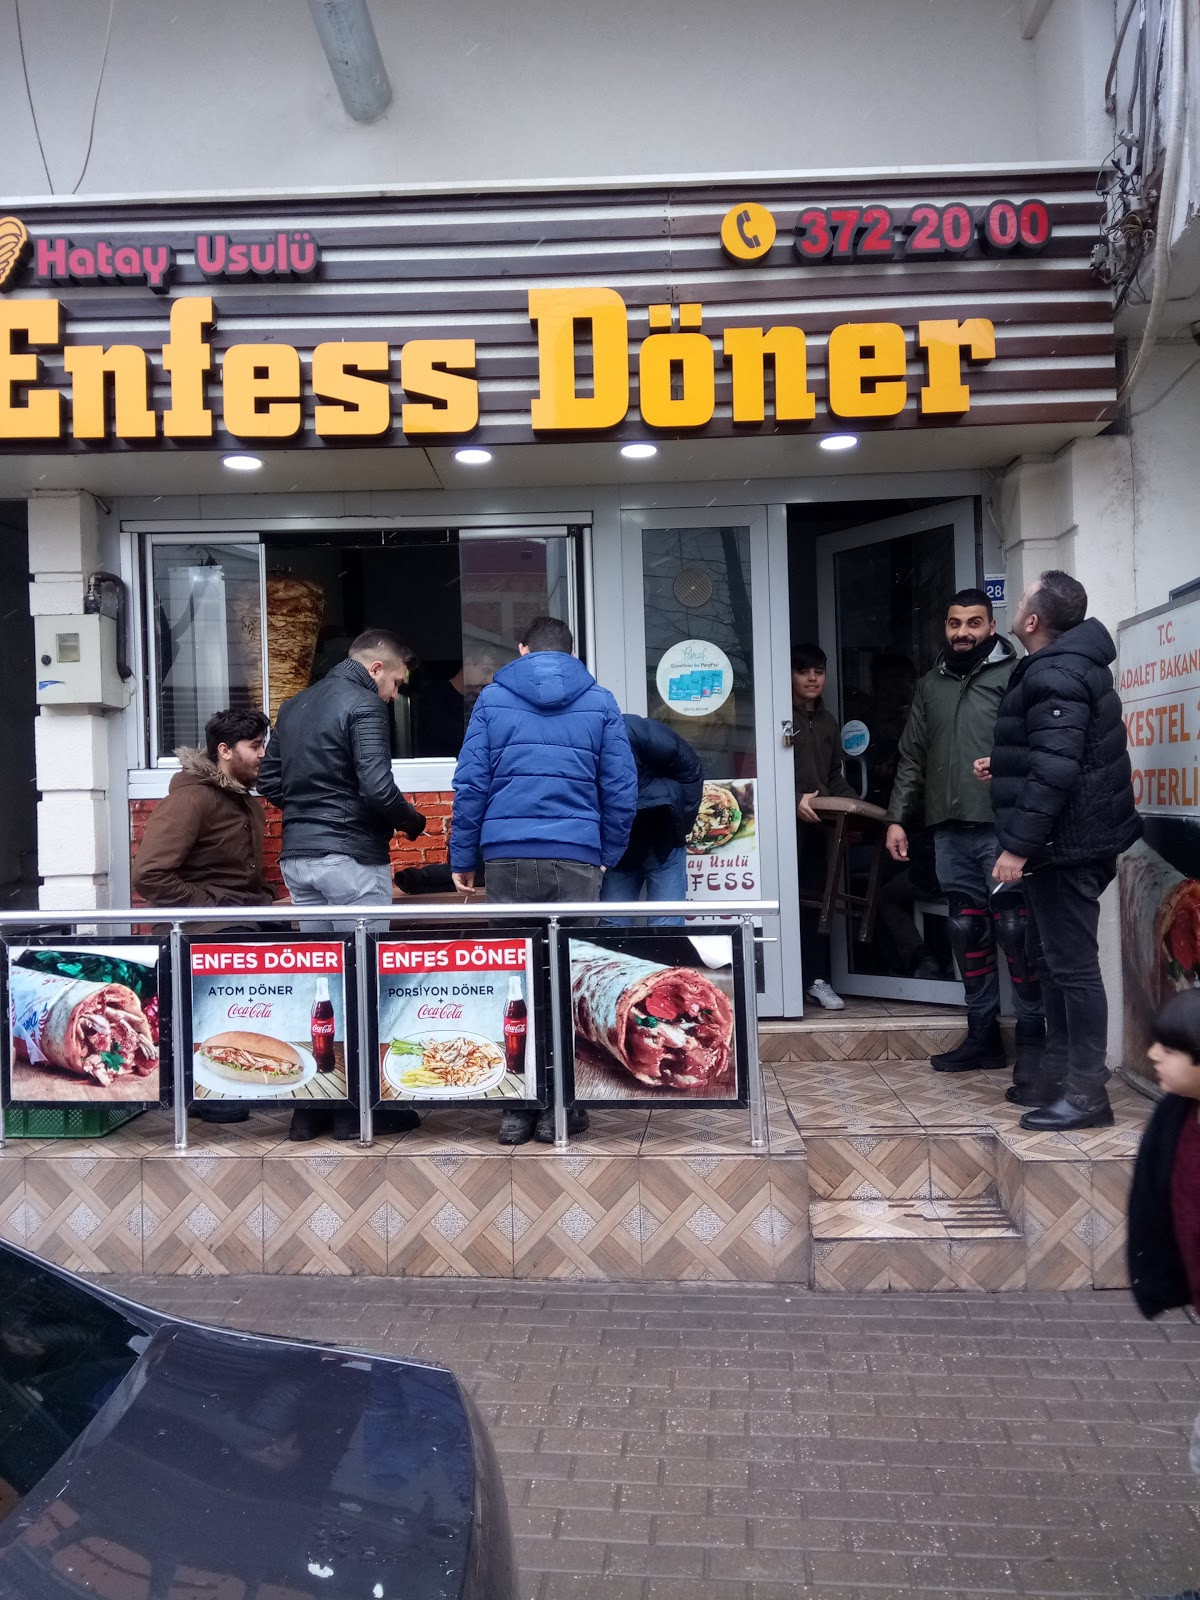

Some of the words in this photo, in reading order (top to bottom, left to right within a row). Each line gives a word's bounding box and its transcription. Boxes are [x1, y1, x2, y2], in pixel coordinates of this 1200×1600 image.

[800, 208, 892, 254] 372
[911, 207, 971, 249] 20
[988, 202, 1049, 245] 00
[37, 238, 168, 285] Hatay
[196, 233, 315, 272] Usulü
[0, 296, 479, 438] Enfess
[528, 287, 996, 430] Döner
[1157, 621, 1176, 646] T.C.
[1120, 661, 1157, 690] ADALET
[1124, 703, 1191, 747] KESTEL
[1131, 755, 1199, 806] OTERLİ
[687, 858, 703, 872] ay
[710, 855, 749, 868] Usulü
[686, 872, 755, 892] FESS
[192, 953, 258, 970] ENFES
[264, 949, 338, 968] DÖNER
[382, 950, 449, 968] ENFES
[208, 986, 245, 996] ATOM
[249, 984, 293, 995] DÖNER
[388, 985, 448, 997] PORSİYON
[453, 984, 494, 995] DÖNER
